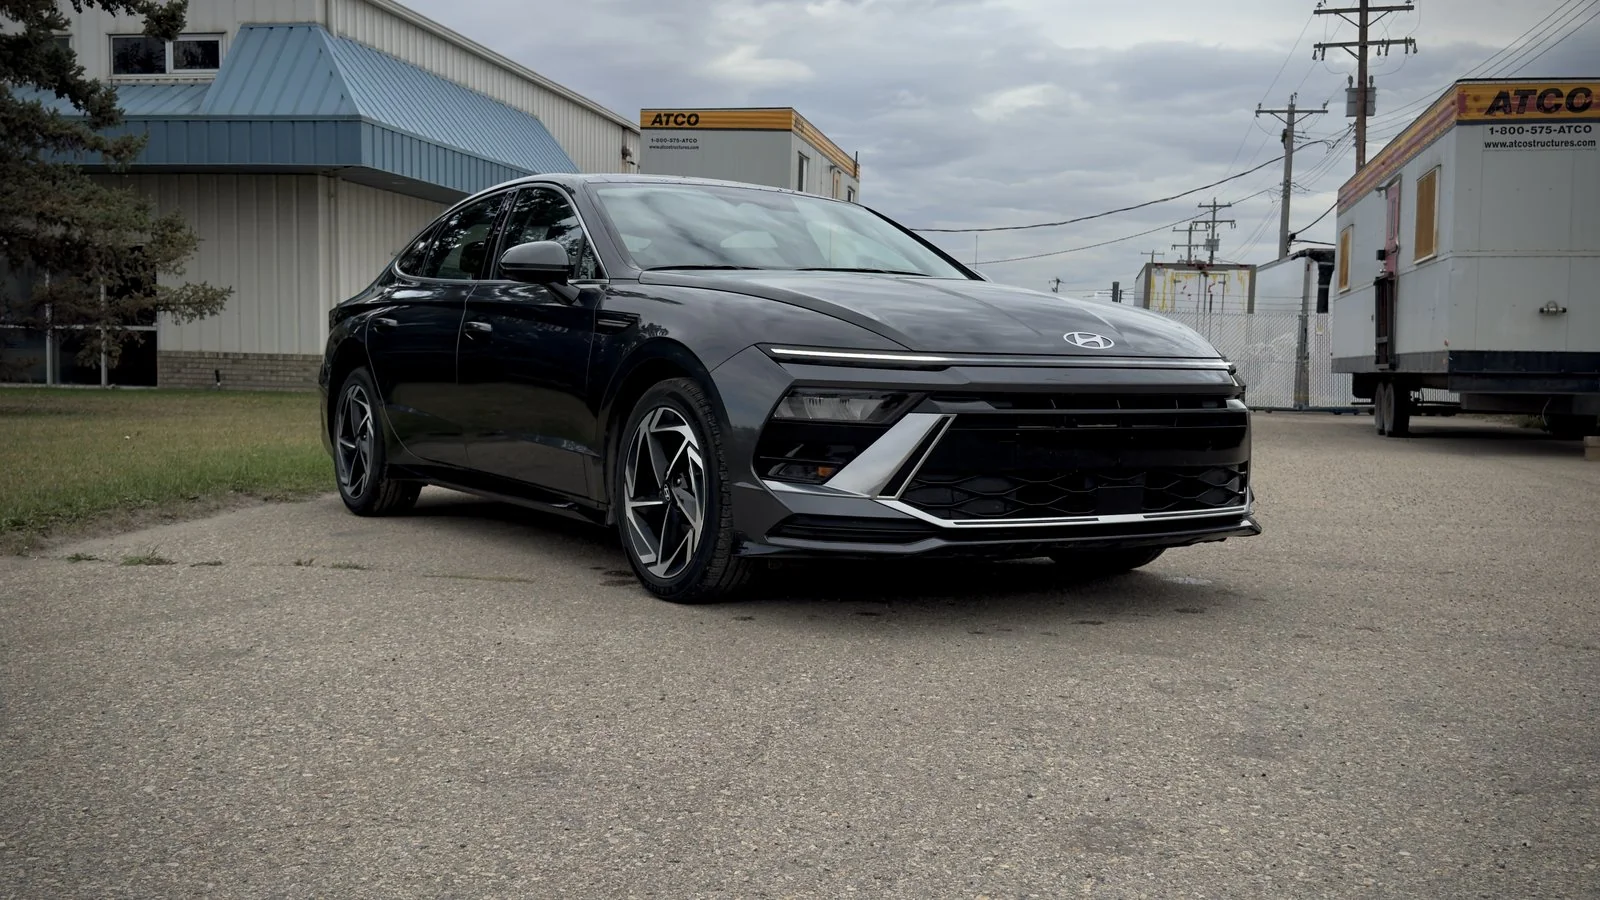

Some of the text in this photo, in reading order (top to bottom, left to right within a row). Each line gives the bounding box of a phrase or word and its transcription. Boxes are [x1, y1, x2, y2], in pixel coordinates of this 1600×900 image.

[1484, 87, 1593, 116] ATCO
[651, 113, 700, 126] ATCO
[1489, 125, 1592, 135] 1-800-575-ATCO
[1484, 139, 1596, 149] www.atcostructures.com
